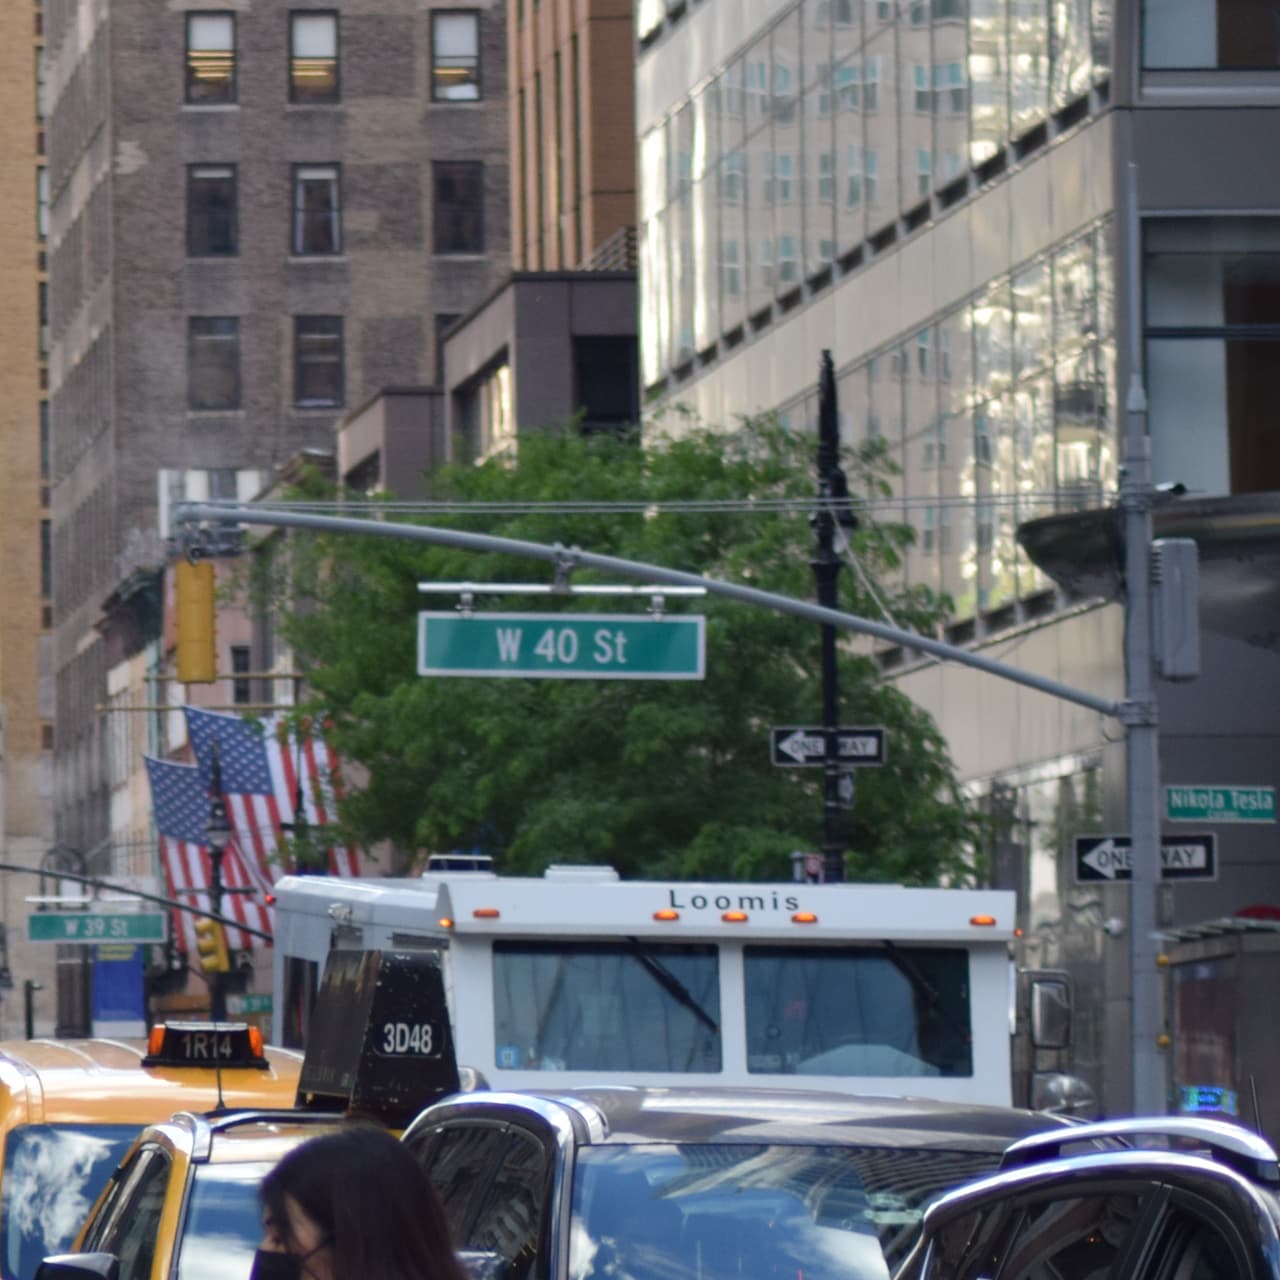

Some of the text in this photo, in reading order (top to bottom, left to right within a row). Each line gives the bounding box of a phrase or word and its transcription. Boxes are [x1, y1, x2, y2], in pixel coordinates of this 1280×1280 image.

[496, 627, 627, 664] W 40 St
[791, 740, 820, 753] ONE
[1171, 790, 1273, 810] Nikola Tesla
[669, 889, 799, 911] Loomis
[64, 918, 128, 936] W 39 St
[182, 1033, 232, 1058] 1R14
[382, 1023, 433, 1054] 3D48
